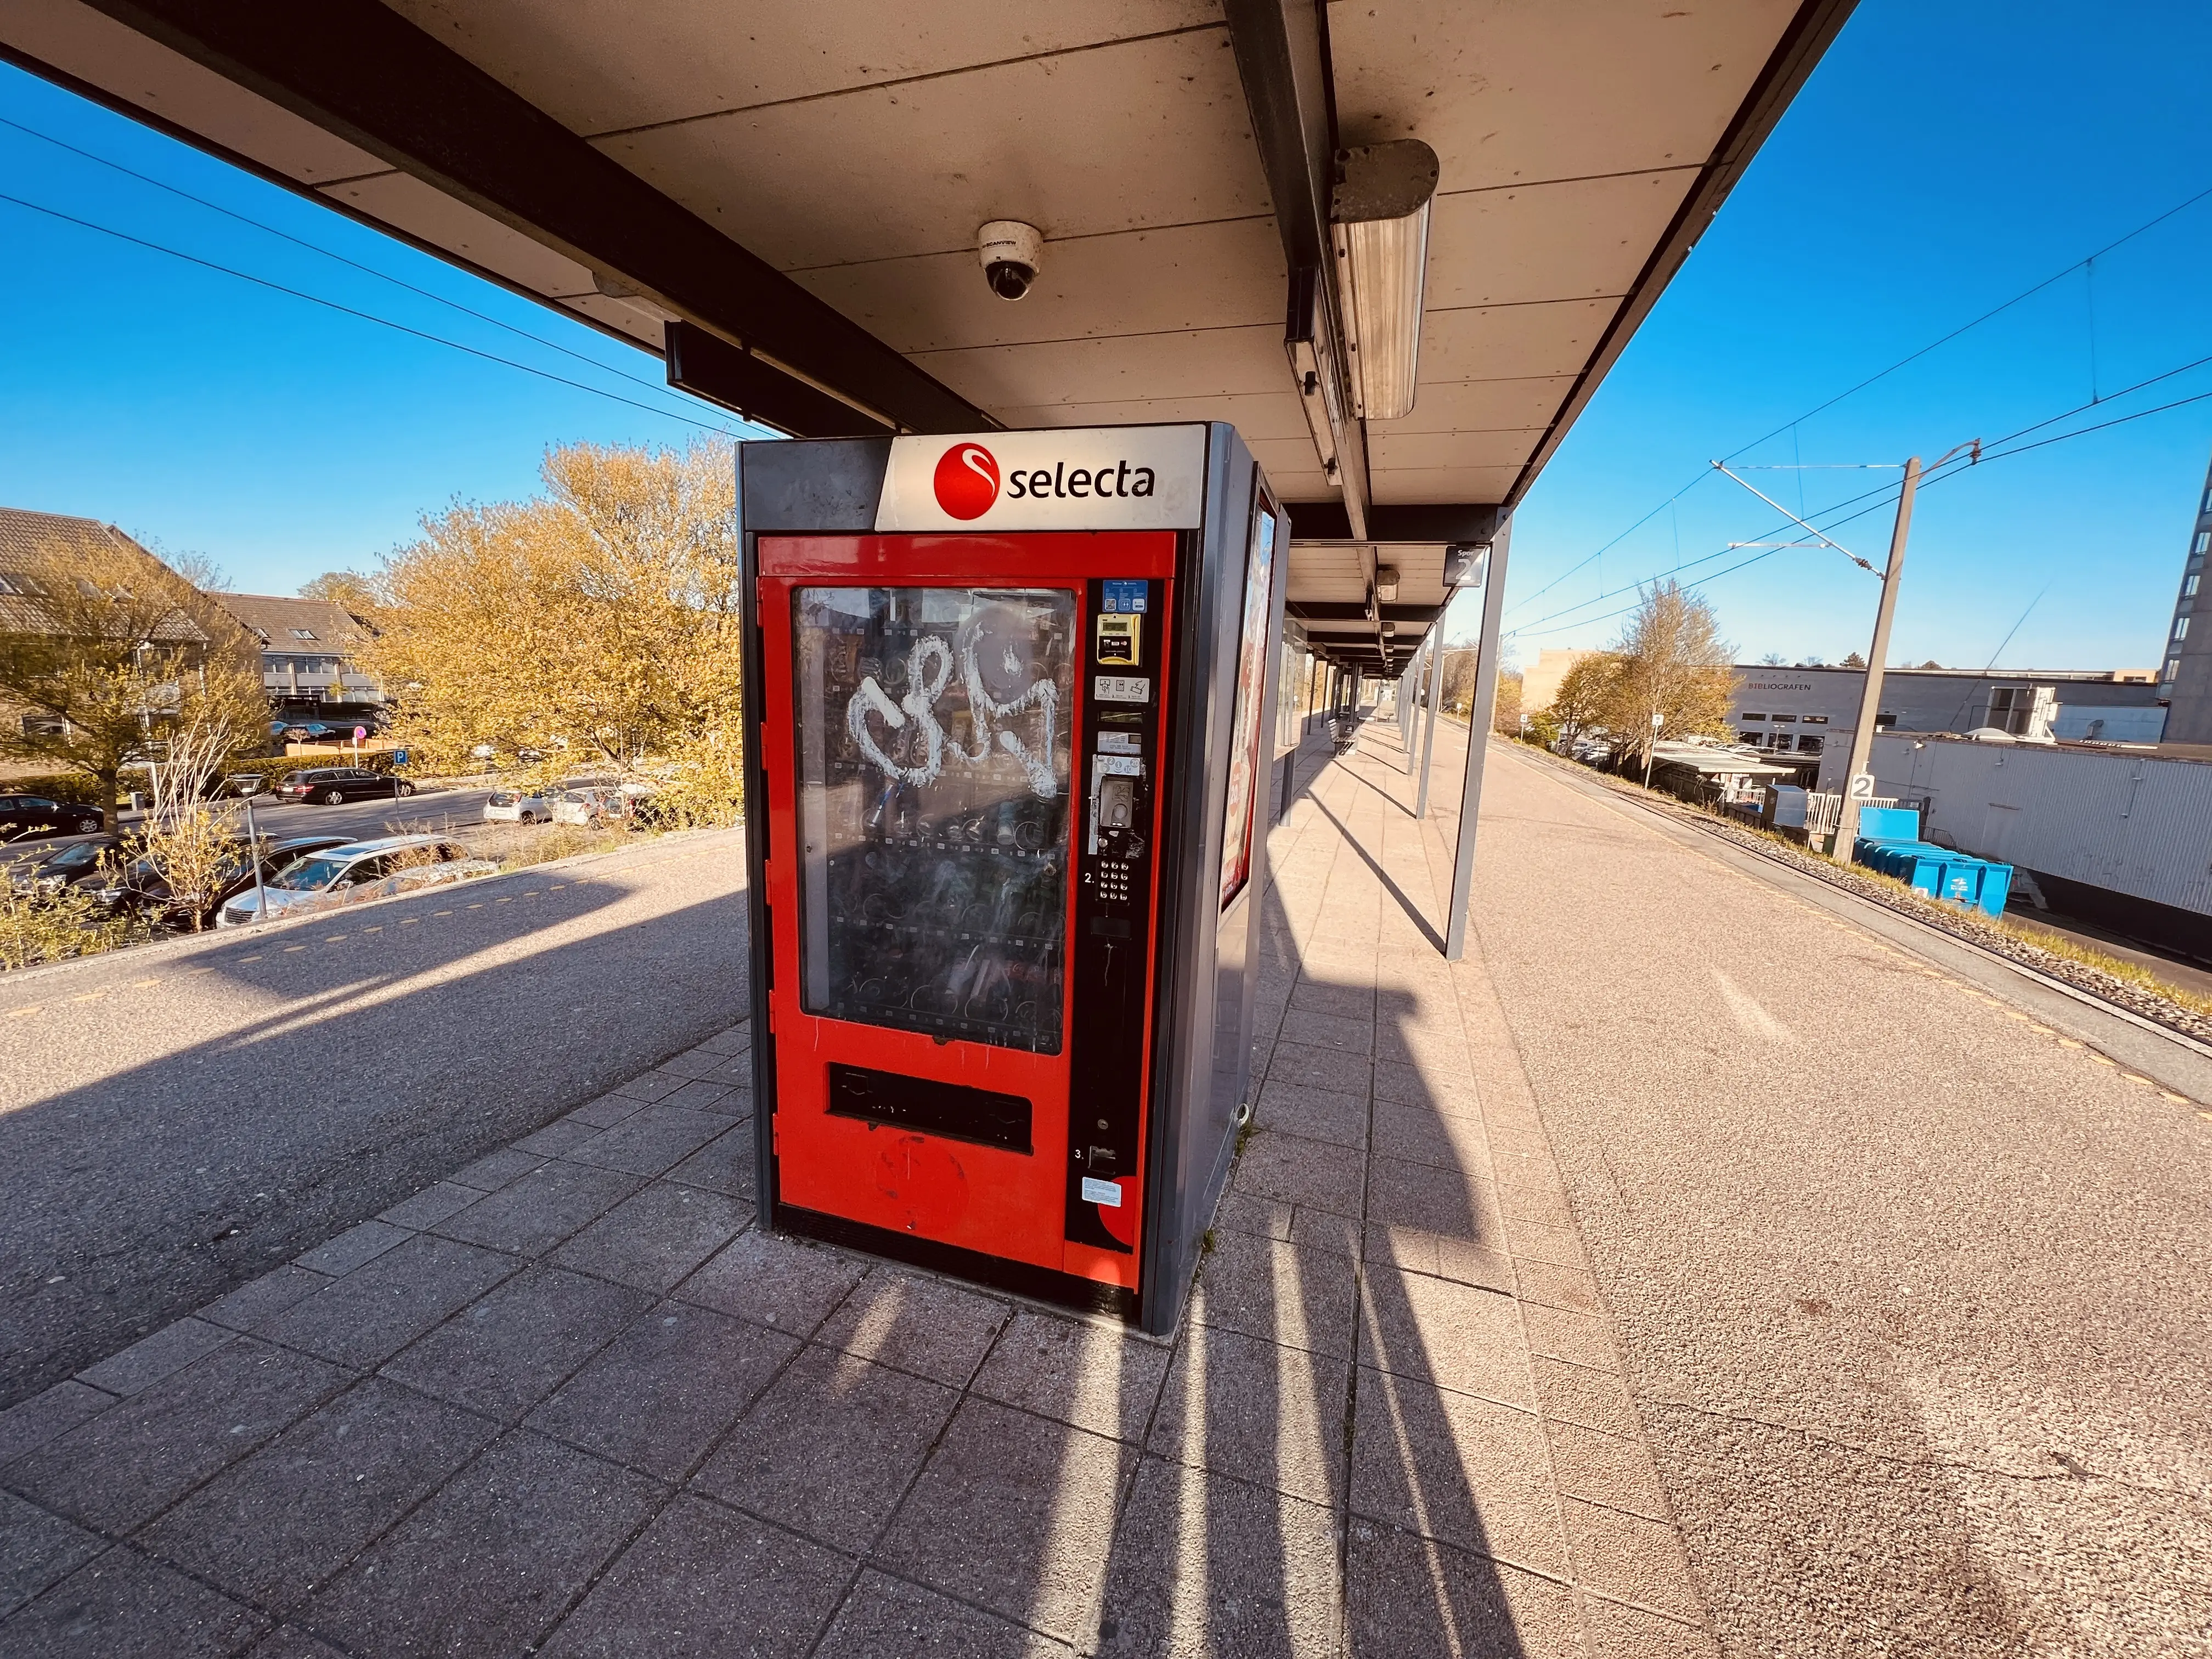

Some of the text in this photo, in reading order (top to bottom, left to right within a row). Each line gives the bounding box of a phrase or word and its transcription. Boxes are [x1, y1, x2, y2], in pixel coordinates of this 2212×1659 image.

[1007, 460, 1155, 499] selecta
[1455, 558, 1471, 580] 2
[1748, 682, 1812, 691] BIBLIOGRAFEN
[397, 752, 404, 762] P
[1853, 777, 1871, 797] 2
[1085, 872, 1094, 883] 2.
[1075, 1149, 1084, 1160] 3.
